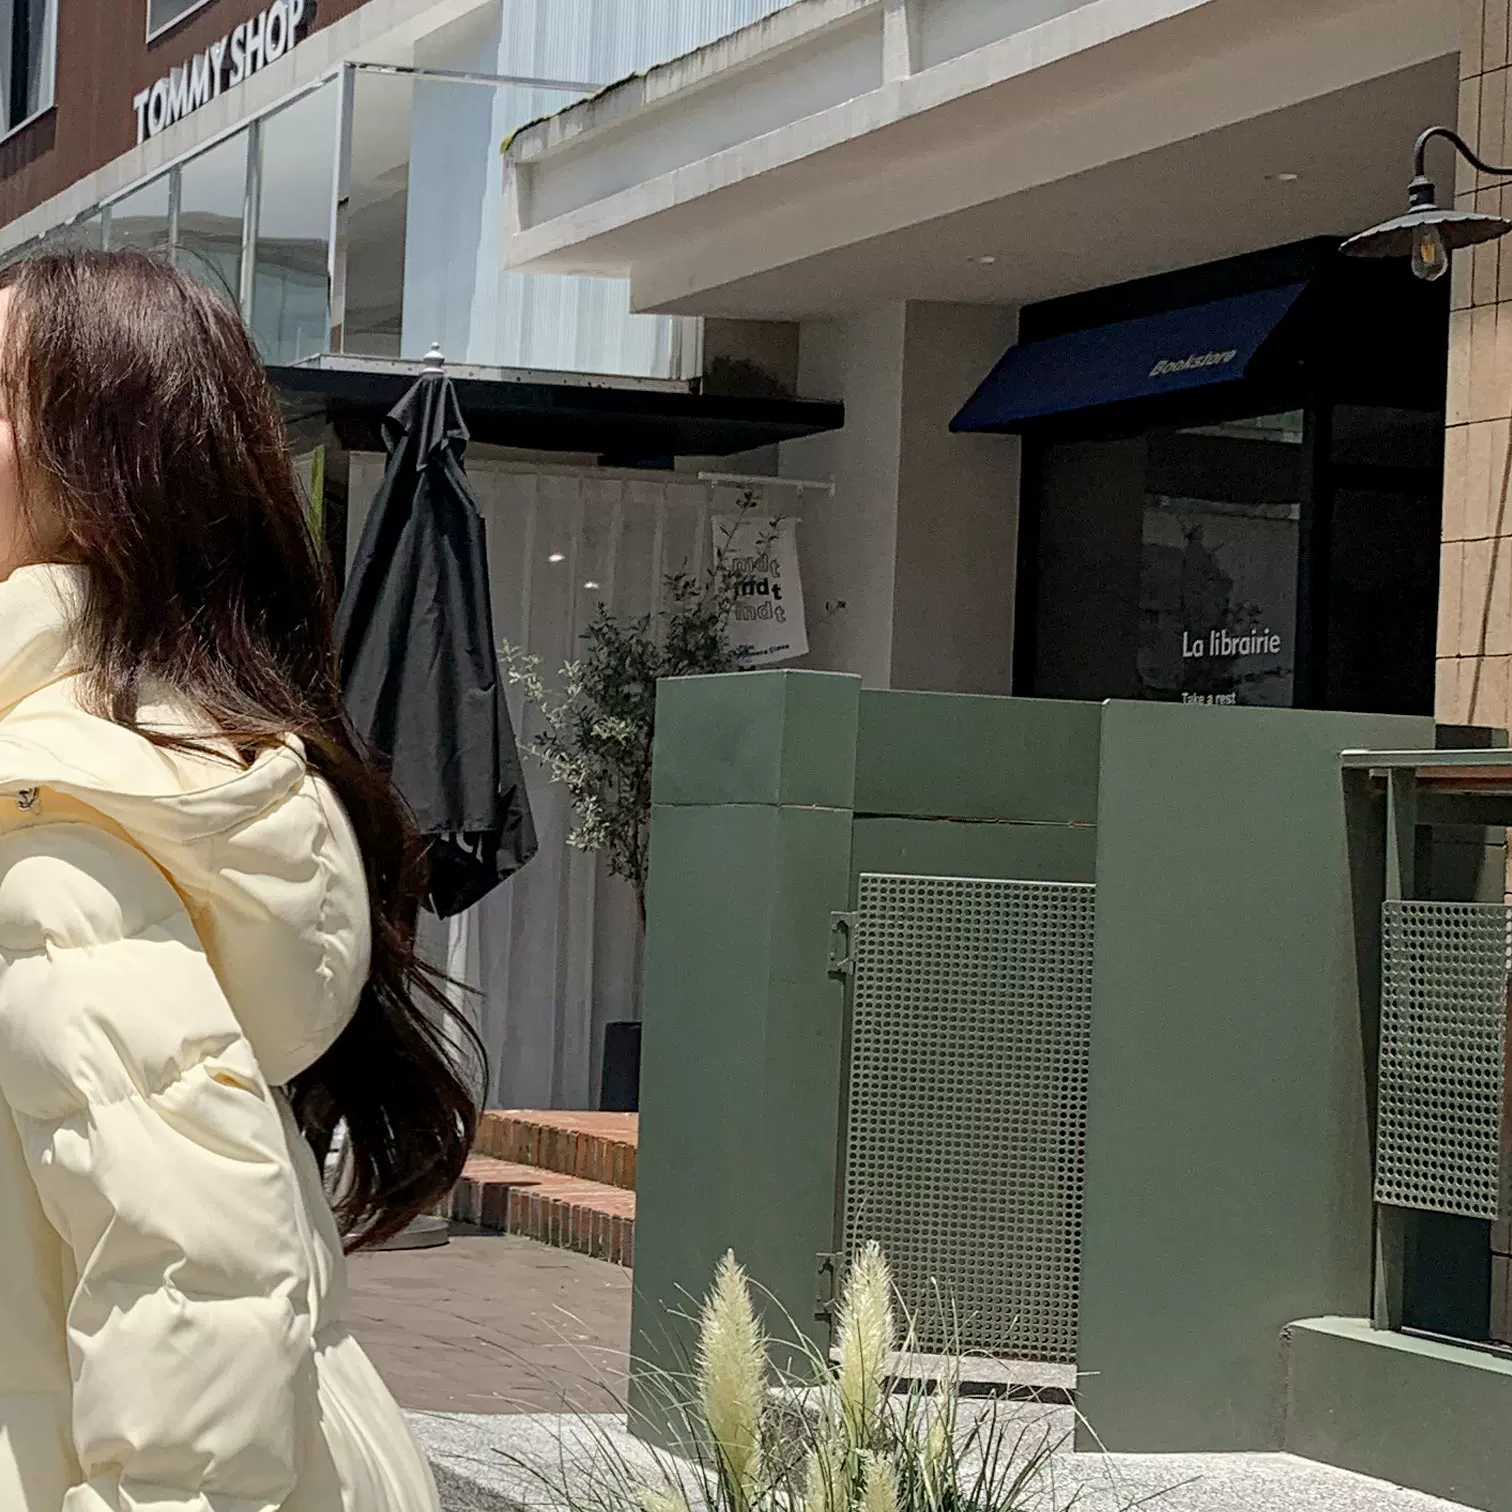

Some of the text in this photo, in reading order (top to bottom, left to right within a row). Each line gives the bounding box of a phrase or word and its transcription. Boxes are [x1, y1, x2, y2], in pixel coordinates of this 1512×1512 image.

[133, 0, 304, 145] TOMMY SHOP
[1149, 349, 1238, 377] Bookstore
[1183, 628, 1281, 658] La librairie
[1181, 692, 1237, 705] Take a rest
